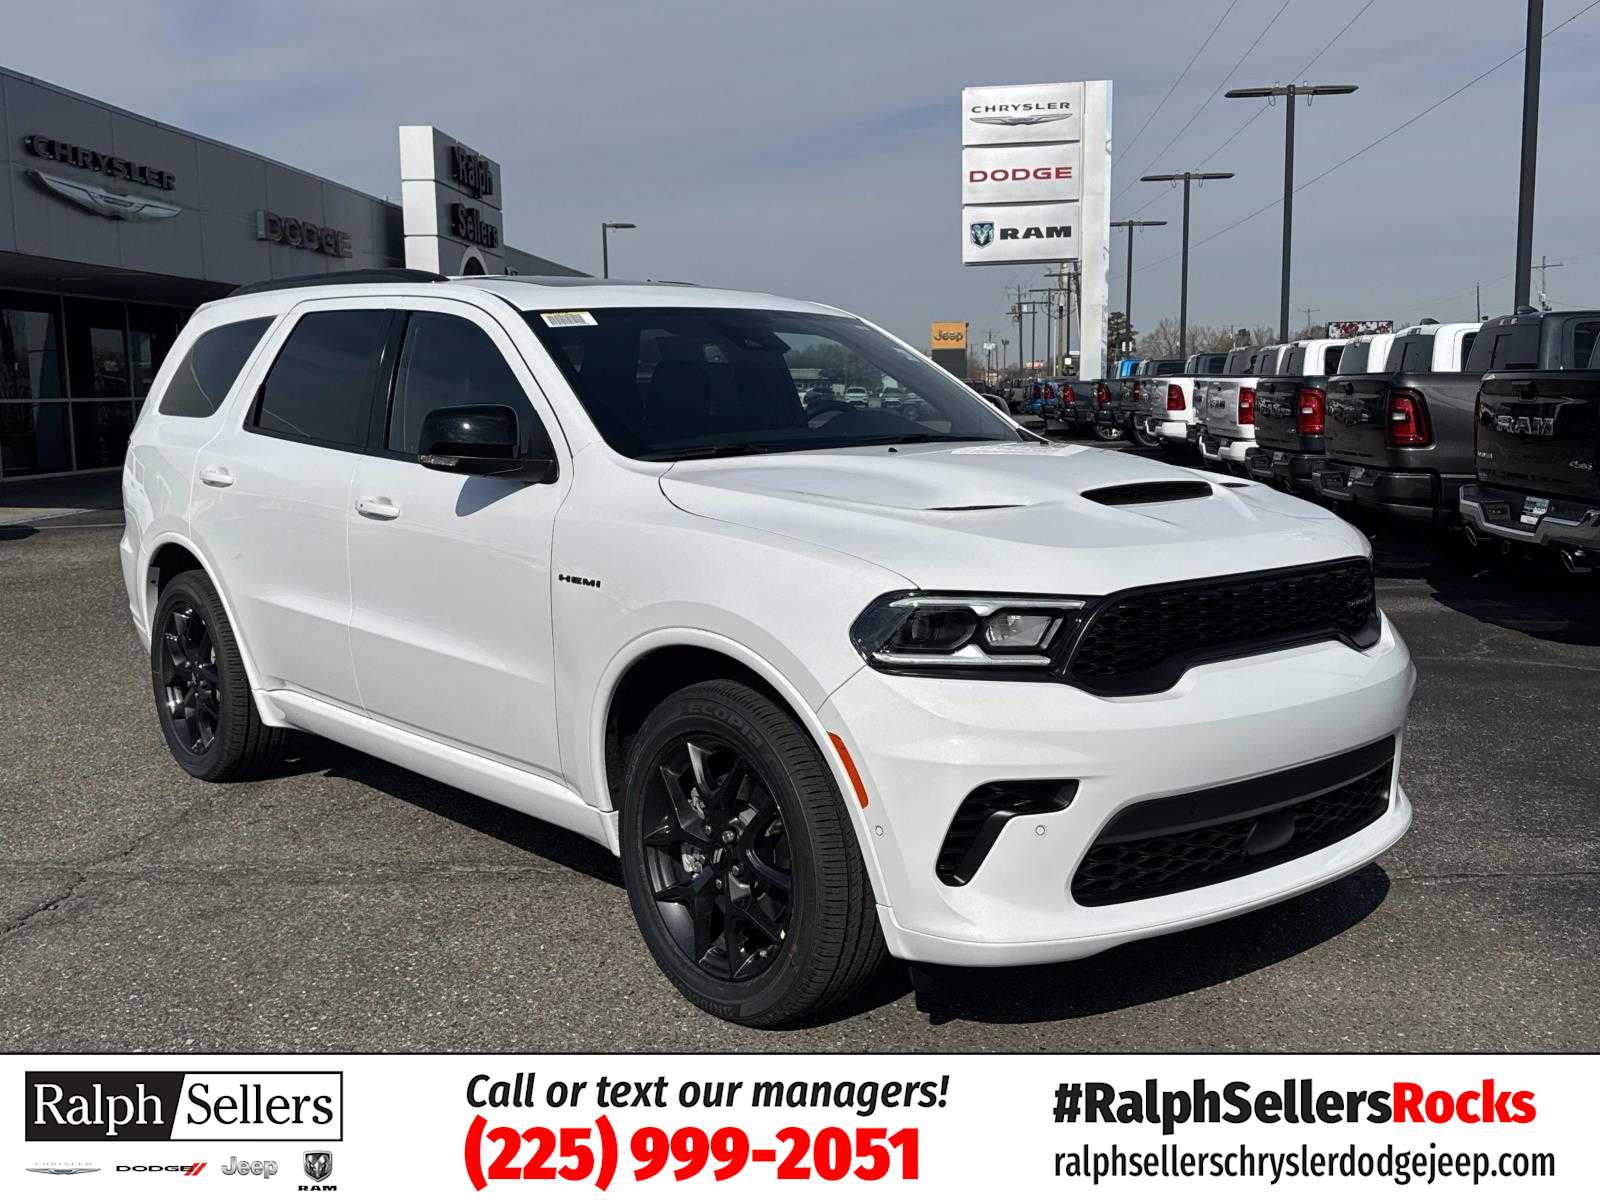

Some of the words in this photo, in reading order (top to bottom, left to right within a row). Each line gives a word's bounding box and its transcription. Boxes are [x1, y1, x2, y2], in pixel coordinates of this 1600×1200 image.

[971, 102, 1071, 113] CHRYSLER
[24, 134, 177, 191] CHRYSLER
[450, 145, 493, 200] Ralph
[969, 167, 1072, 183] DODGE
[256, 209, 353, 258] DODGE
[450, 202, 499, 248] Sellers
[1000, 226, 1072, 240] RAM
[933, 330, 964, 342] Jeep
[1496, 415, 1556, 437] RAM
[558, 573, 601, 588] HEMI
